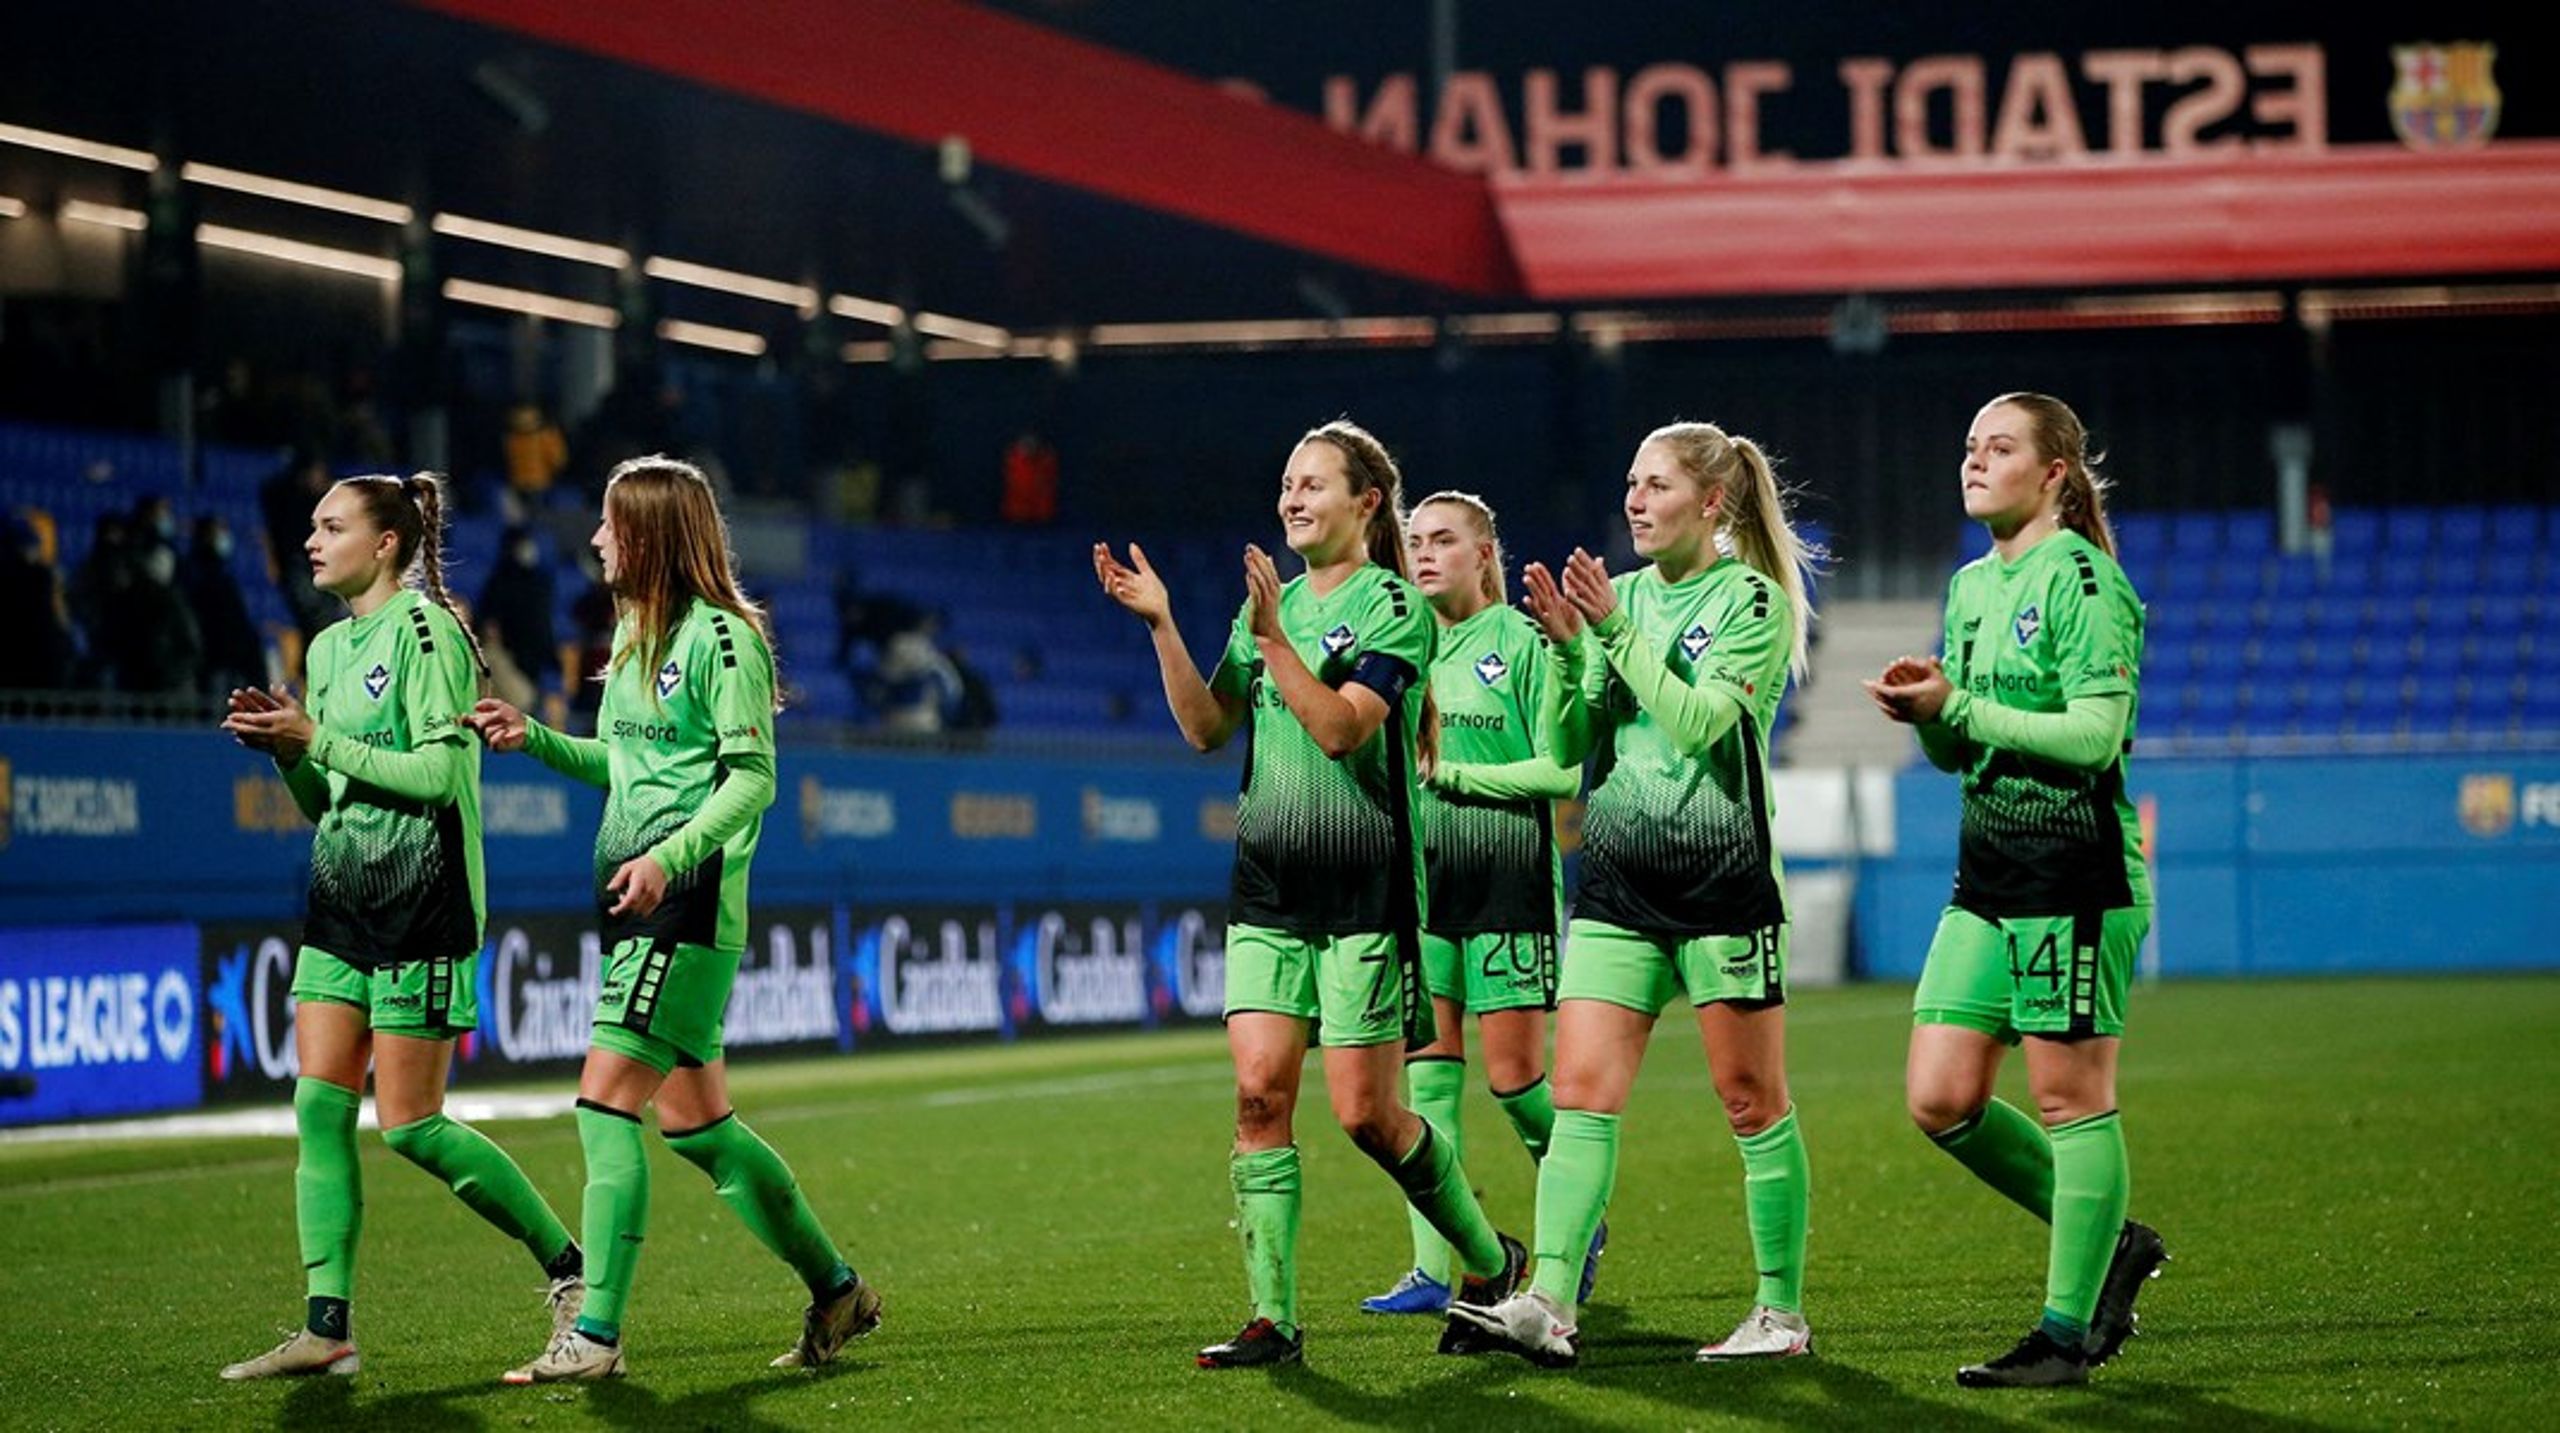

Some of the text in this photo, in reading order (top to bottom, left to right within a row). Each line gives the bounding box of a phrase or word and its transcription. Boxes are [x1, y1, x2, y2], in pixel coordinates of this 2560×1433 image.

[1974, 672, 2039, 697] spNord
[1439, 711, 1506, 732] arNord
[1359, 954, 1389, 1013] 7
[28, 971, 151, 1070] LEAGUE
